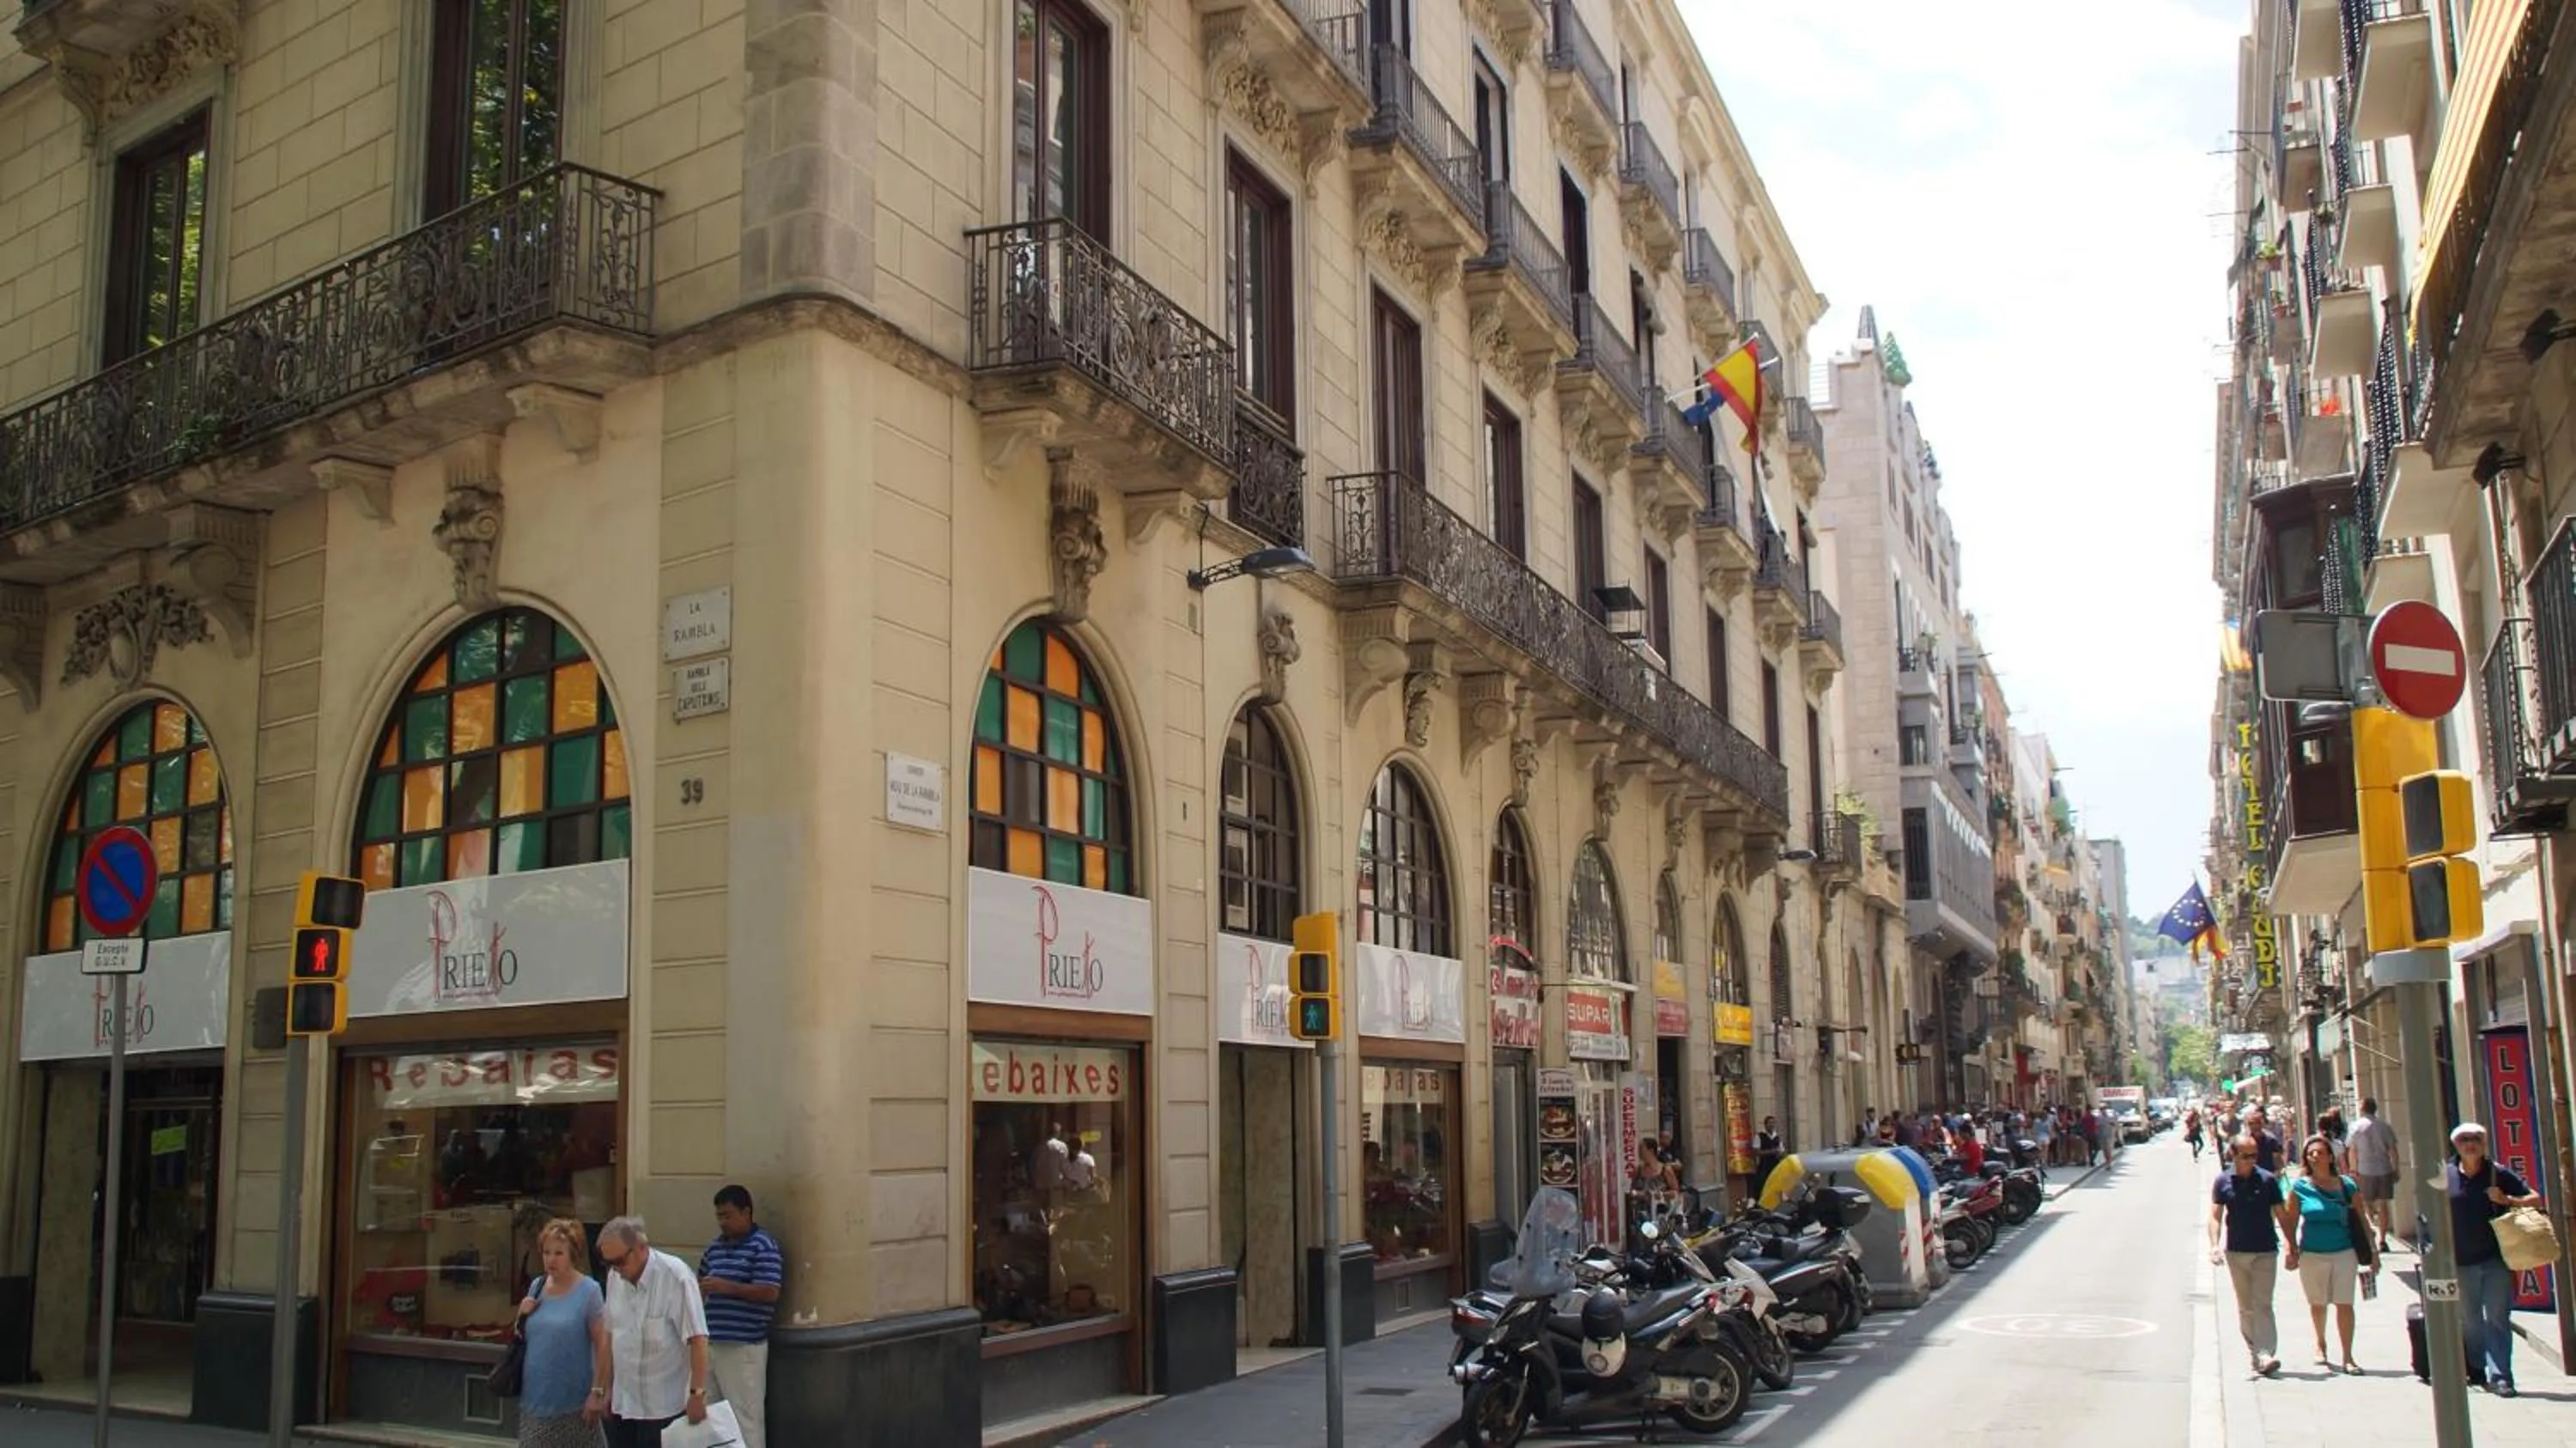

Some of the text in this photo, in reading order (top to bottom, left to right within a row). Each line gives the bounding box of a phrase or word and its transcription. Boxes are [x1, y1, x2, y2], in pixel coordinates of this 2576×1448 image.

[673, 622, 716, 643] RAMBLA
[680, 778, 704, 806] 39
[972, 1050, 1120, 1096] ebaixes
[2497, 1044, 2544, 1296] LOTEA
